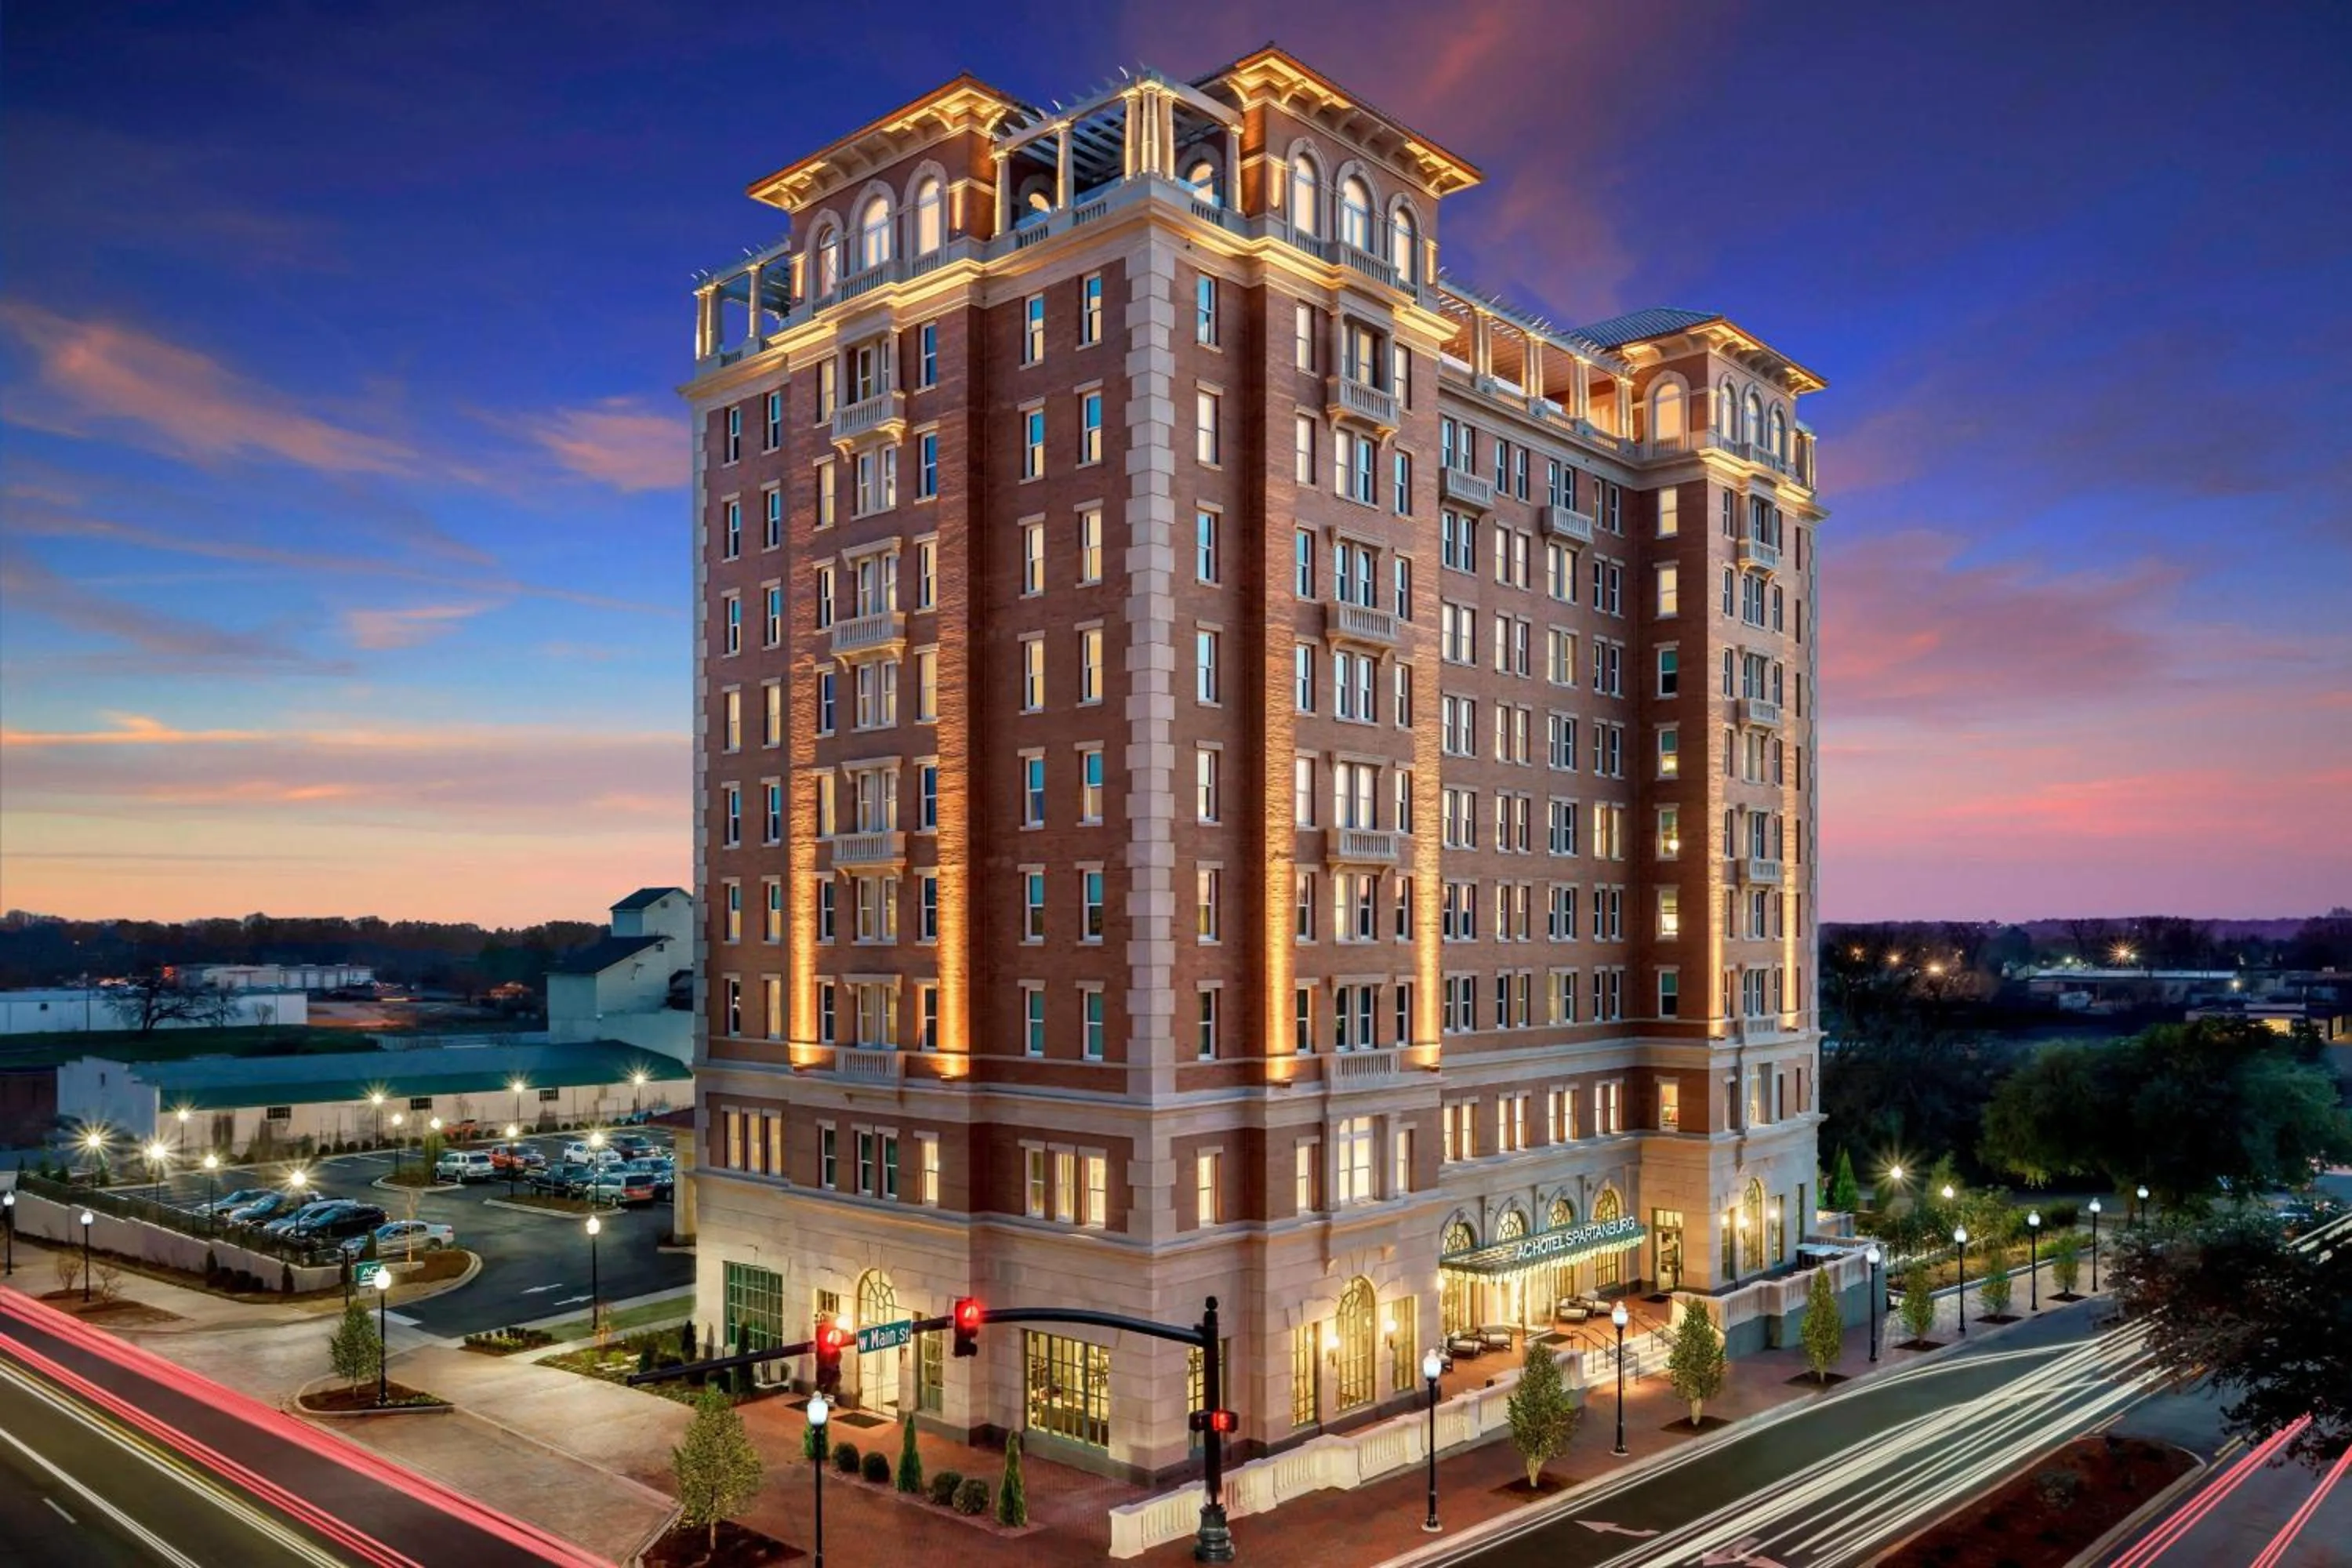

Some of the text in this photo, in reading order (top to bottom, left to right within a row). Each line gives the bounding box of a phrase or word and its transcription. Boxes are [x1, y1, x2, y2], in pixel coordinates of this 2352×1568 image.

[1517, 1216, 1635, 1259] AC HOTEL SPARTANBURG
[871, 1327, 896, 1348] Main
[899, 1327, 909, 1342] St
